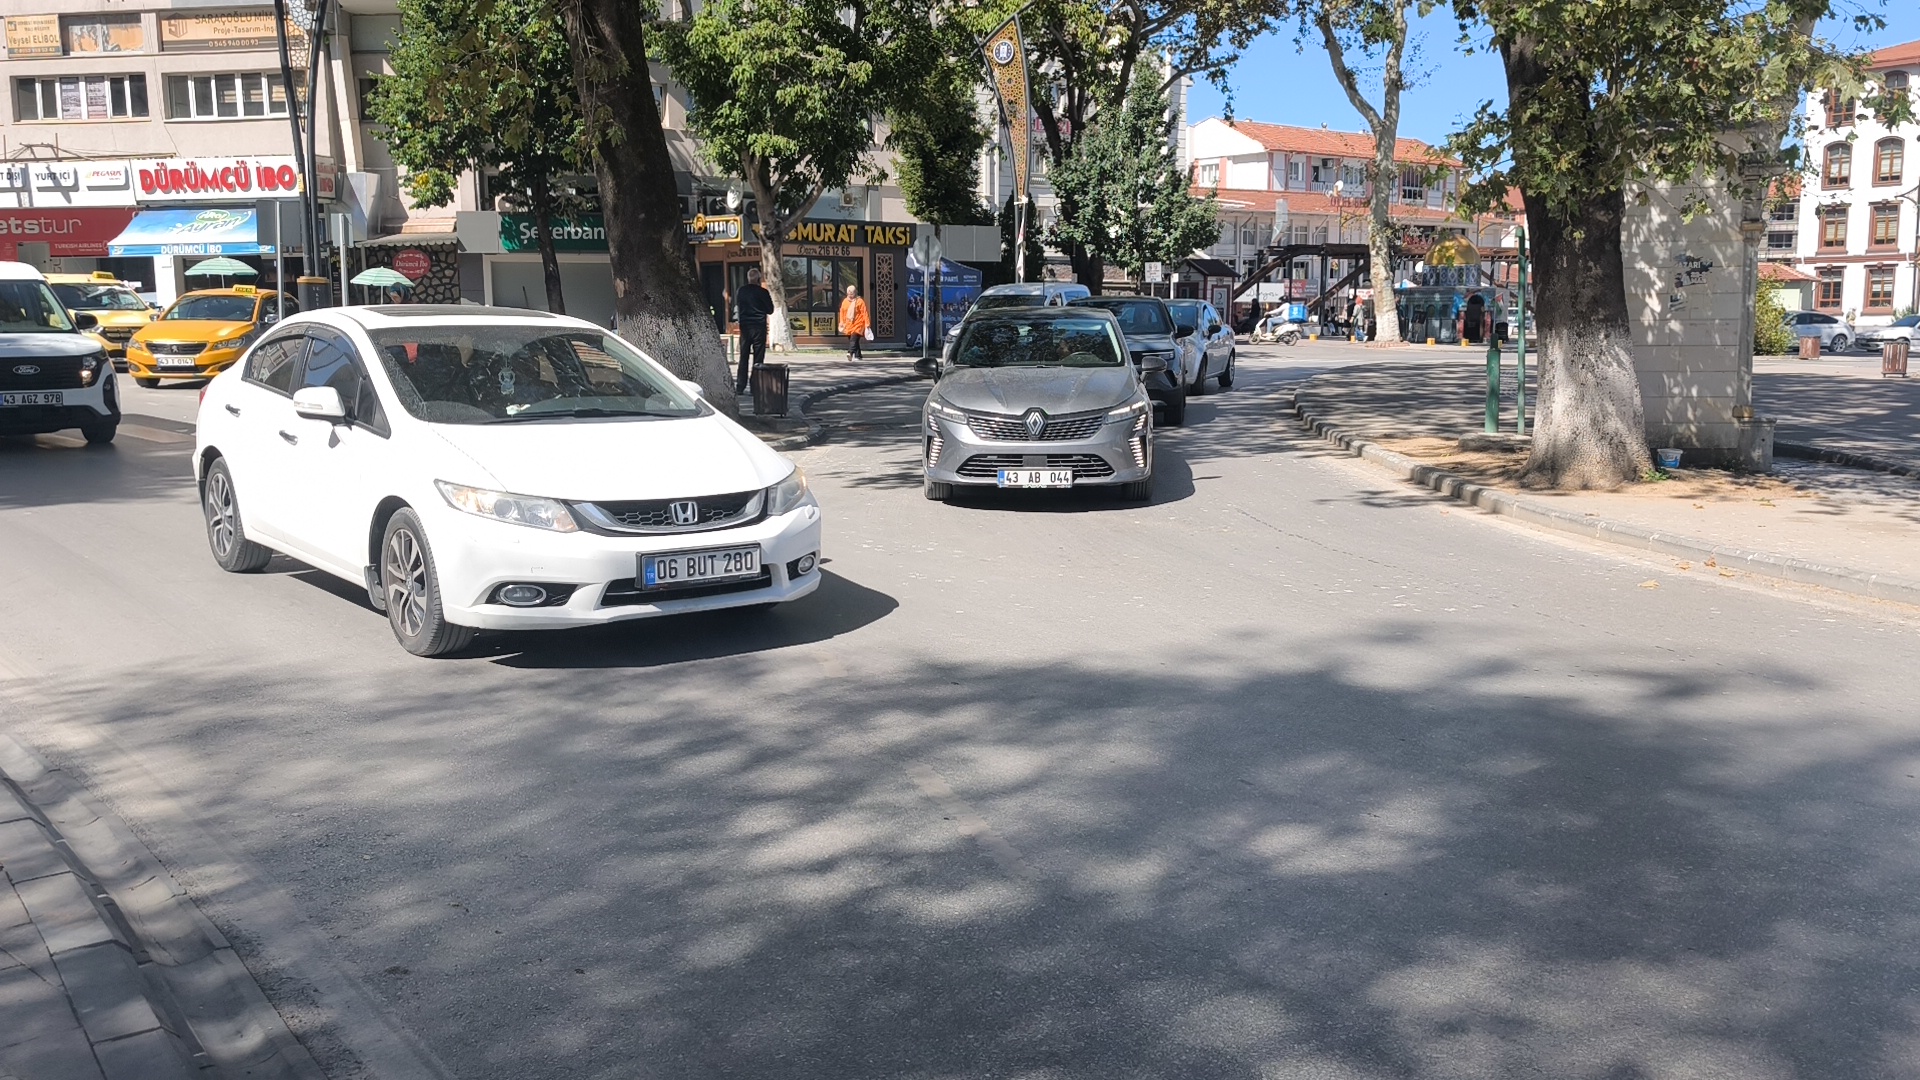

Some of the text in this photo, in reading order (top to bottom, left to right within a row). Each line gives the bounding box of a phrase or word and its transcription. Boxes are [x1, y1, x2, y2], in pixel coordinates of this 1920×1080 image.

[195, 9, 276, 25] SARAÇOĞLU MİM
[213, 25, 276, 35] Proje-Tasarım-İnş
[35, 172, 57, 181] YURT
[139, 160, 251, 193] DÜRÜMCÜ
[255, 161, 297, 191] İBO
[797, 222, 858, 243] MURAT
[160, 242, 222, 254] DÜRÜMCÜ İBO
[818, 246, 831, 255] 216
[831, 246, 840, 255] 12
[841, 246, 851, 256] 66
[4, 393, 61, 405] 43 AGZ 978
[1006, 471, 1070, 483] 43 AB 044
[656, 551, 754, 580] 06 BUT 280
